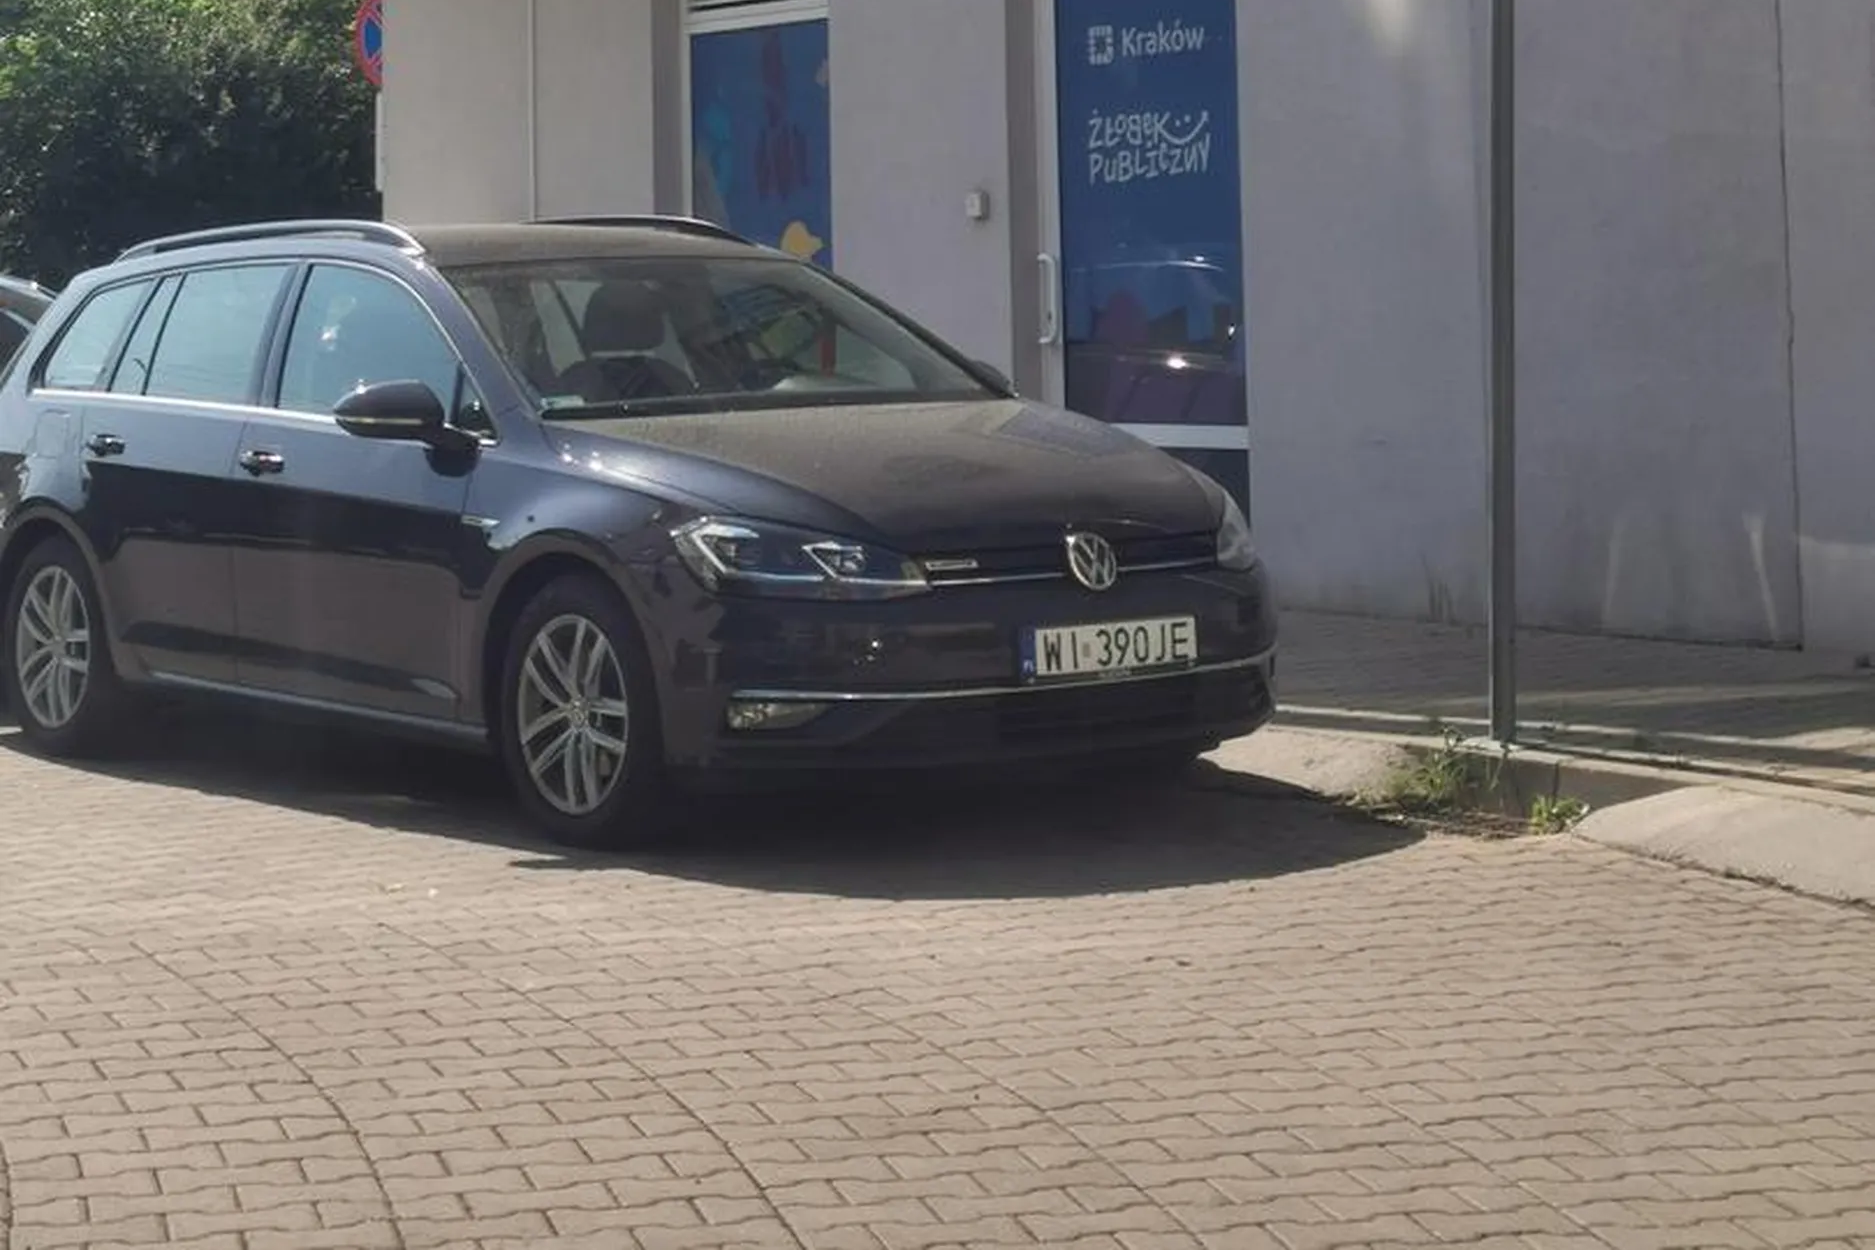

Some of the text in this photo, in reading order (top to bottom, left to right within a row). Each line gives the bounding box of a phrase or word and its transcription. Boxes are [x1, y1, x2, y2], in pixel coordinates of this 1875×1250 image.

[1121, 18, 1205, 58] Kraków
[1042, 630, 1079, 672] WI
[1095, 621, 1190, 667] 390JE
